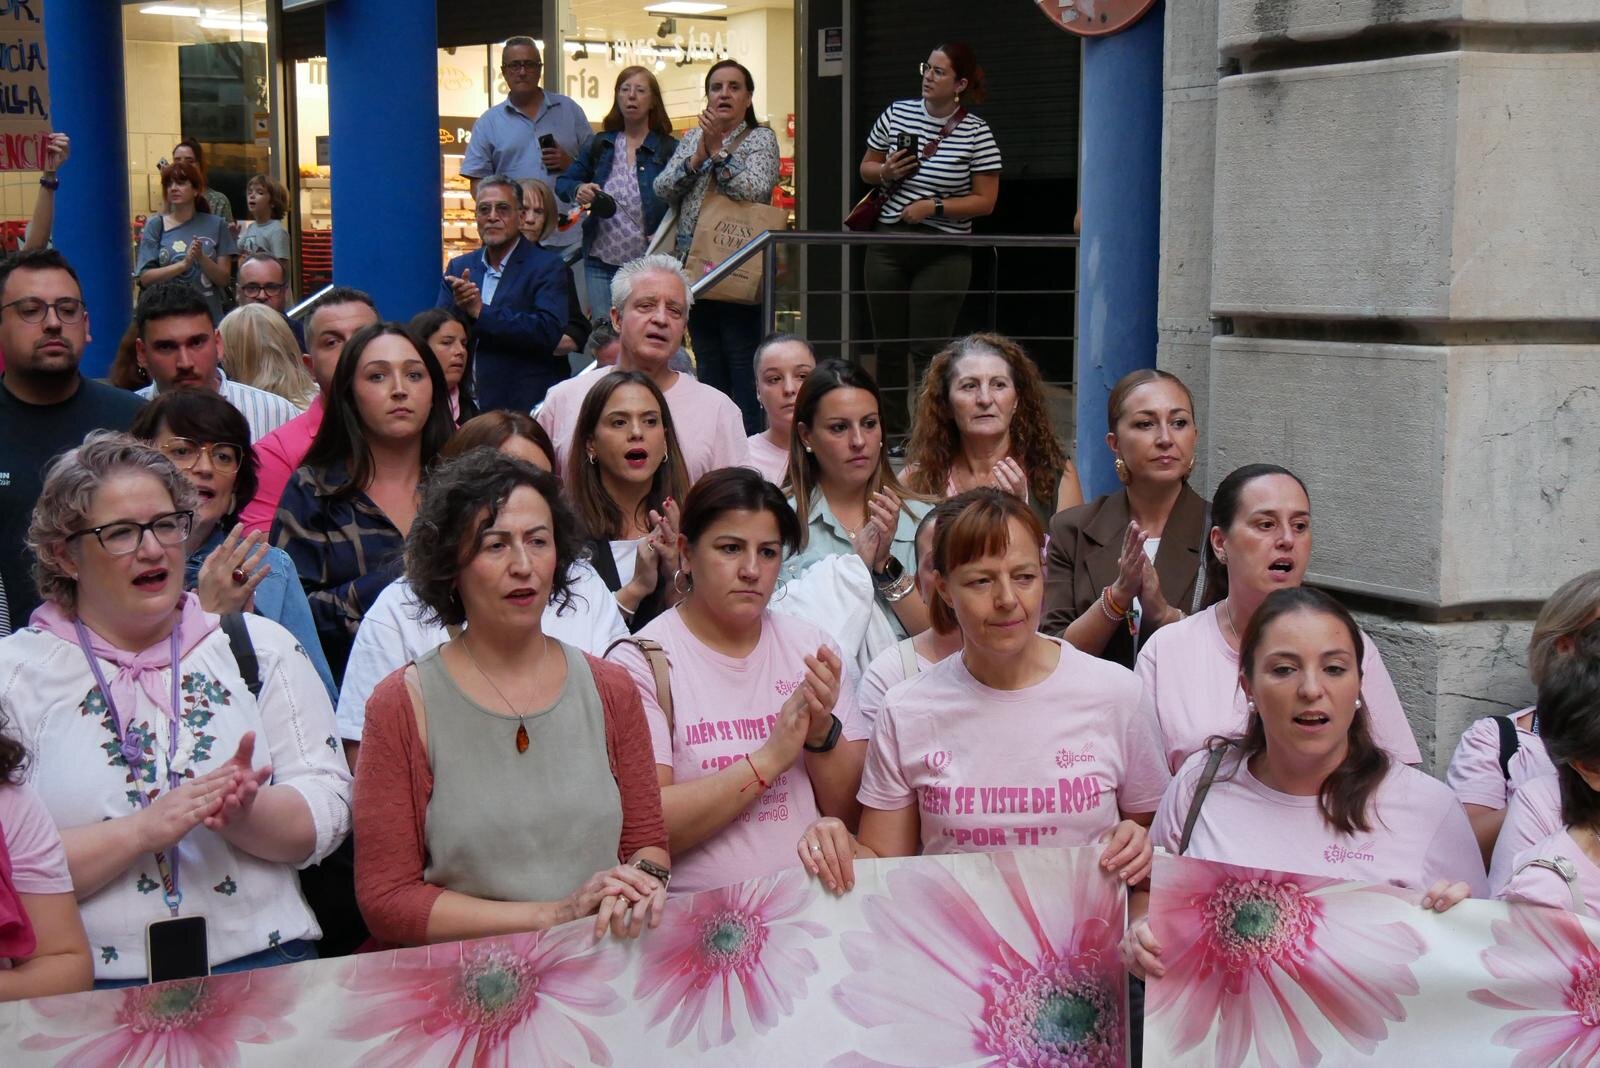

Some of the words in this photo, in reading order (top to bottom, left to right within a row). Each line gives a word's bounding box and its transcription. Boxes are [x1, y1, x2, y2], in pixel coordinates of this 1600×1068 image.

[685, 716, 717, 746] JAÉN
[717, 720, 734, 741] SE
[732, 717, 767, 741] VISTE
[955, 786, 976, 815] SE
[980, 786, 1029, 814] VISTE
[1031, 787, 1056, 814] DE
